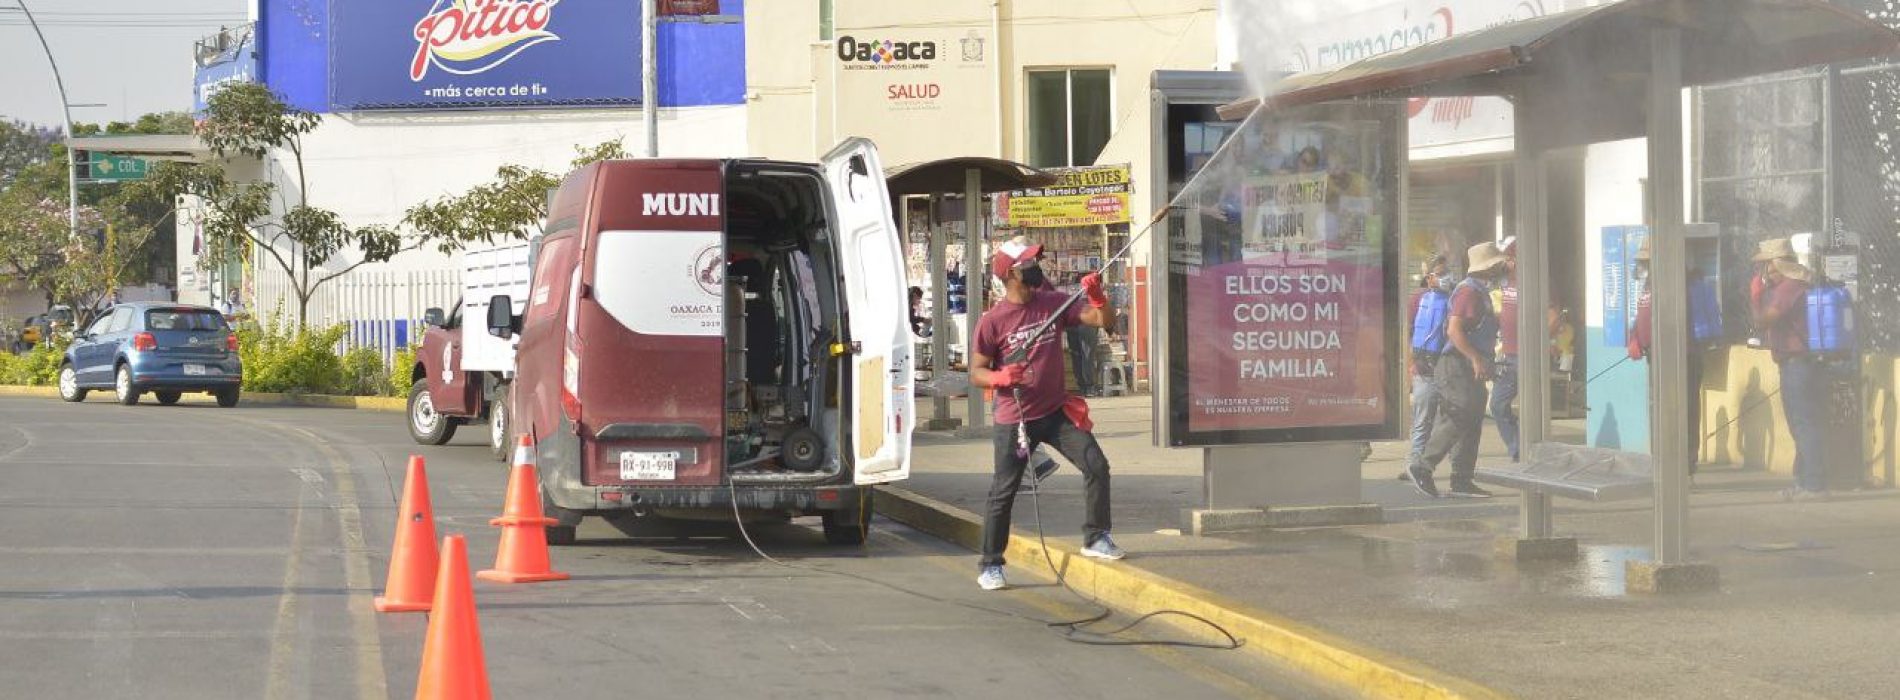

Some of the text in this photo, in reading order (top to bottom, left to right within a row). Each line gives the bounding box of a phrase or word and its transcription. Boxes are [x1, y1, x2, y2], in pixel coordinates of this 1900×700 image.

[432, 83, 540, 97] más cerca de ti
[888, 84, 940, 99] SALUD
[1085, 170, 1121, 185] LOTES
[1044, 187, 1077, 196] Bartolo
[642, 193, 720, 216] MUNI
[1225, 274, 1346, 294] ELLOS SON
[670, 305, 713, 314] OAXACA
[1234, 302, 1338, 323] COMO MI
[1232, 331, 1342, 351] SEGUNDA
[1240, 358, 1334, 379] FAMILIA.
